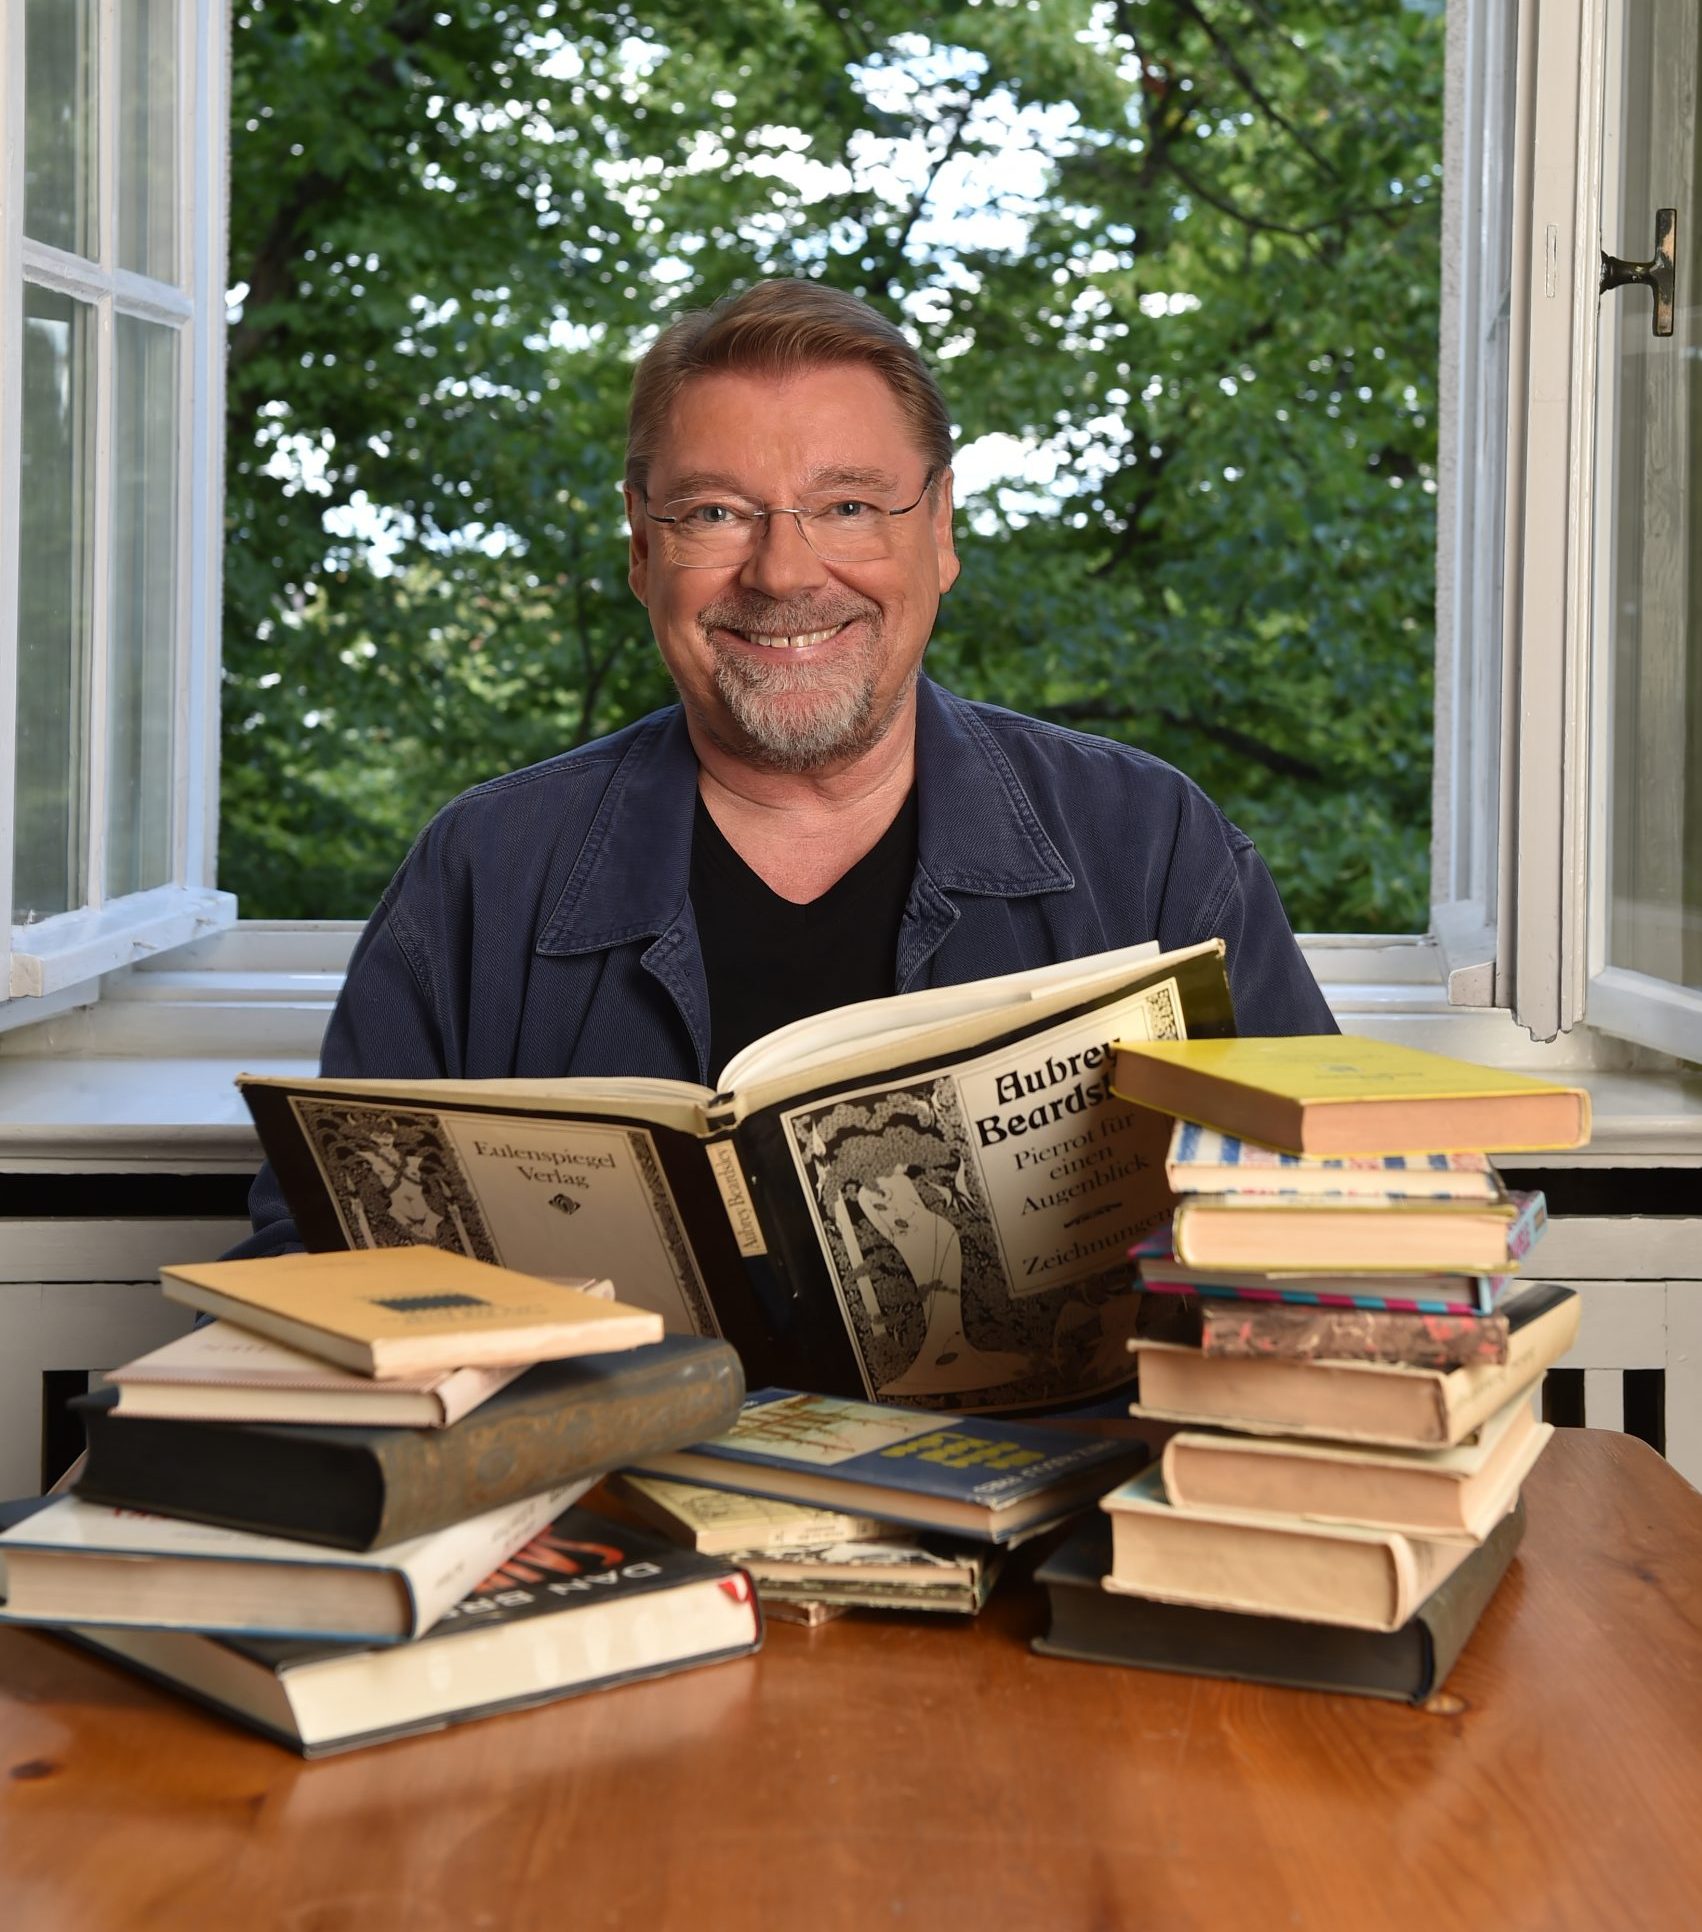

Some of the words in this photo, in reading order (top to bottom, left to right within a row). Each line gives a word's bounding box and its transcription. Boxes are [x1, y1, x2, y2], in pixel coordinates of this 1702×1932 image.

[995, 1038, 1121, 1106] Aubrey
[976, 1071, 1116, 1148] Beardsl
[473, 1140, 616, 1170] Eulenspiegel
[1014, 1129, 1095, 1171] Pierrot
[1100, 1113, 1136, 1138] für
[1049, 1147, 1113, 1180] einen
[517, 1165, 590, 1189] Verlag
[716, 1148, 745, 1207] Beardsley
[1020, 1154, 1149, 1216] Augenblick
[737, 1208, 760, 1249] Aubrey
[1022, 1207, 1172, 1277] Zeichnungen
[548, 1561, 662, 1597] DAN
[441, 1589, 535, 1621] BR
